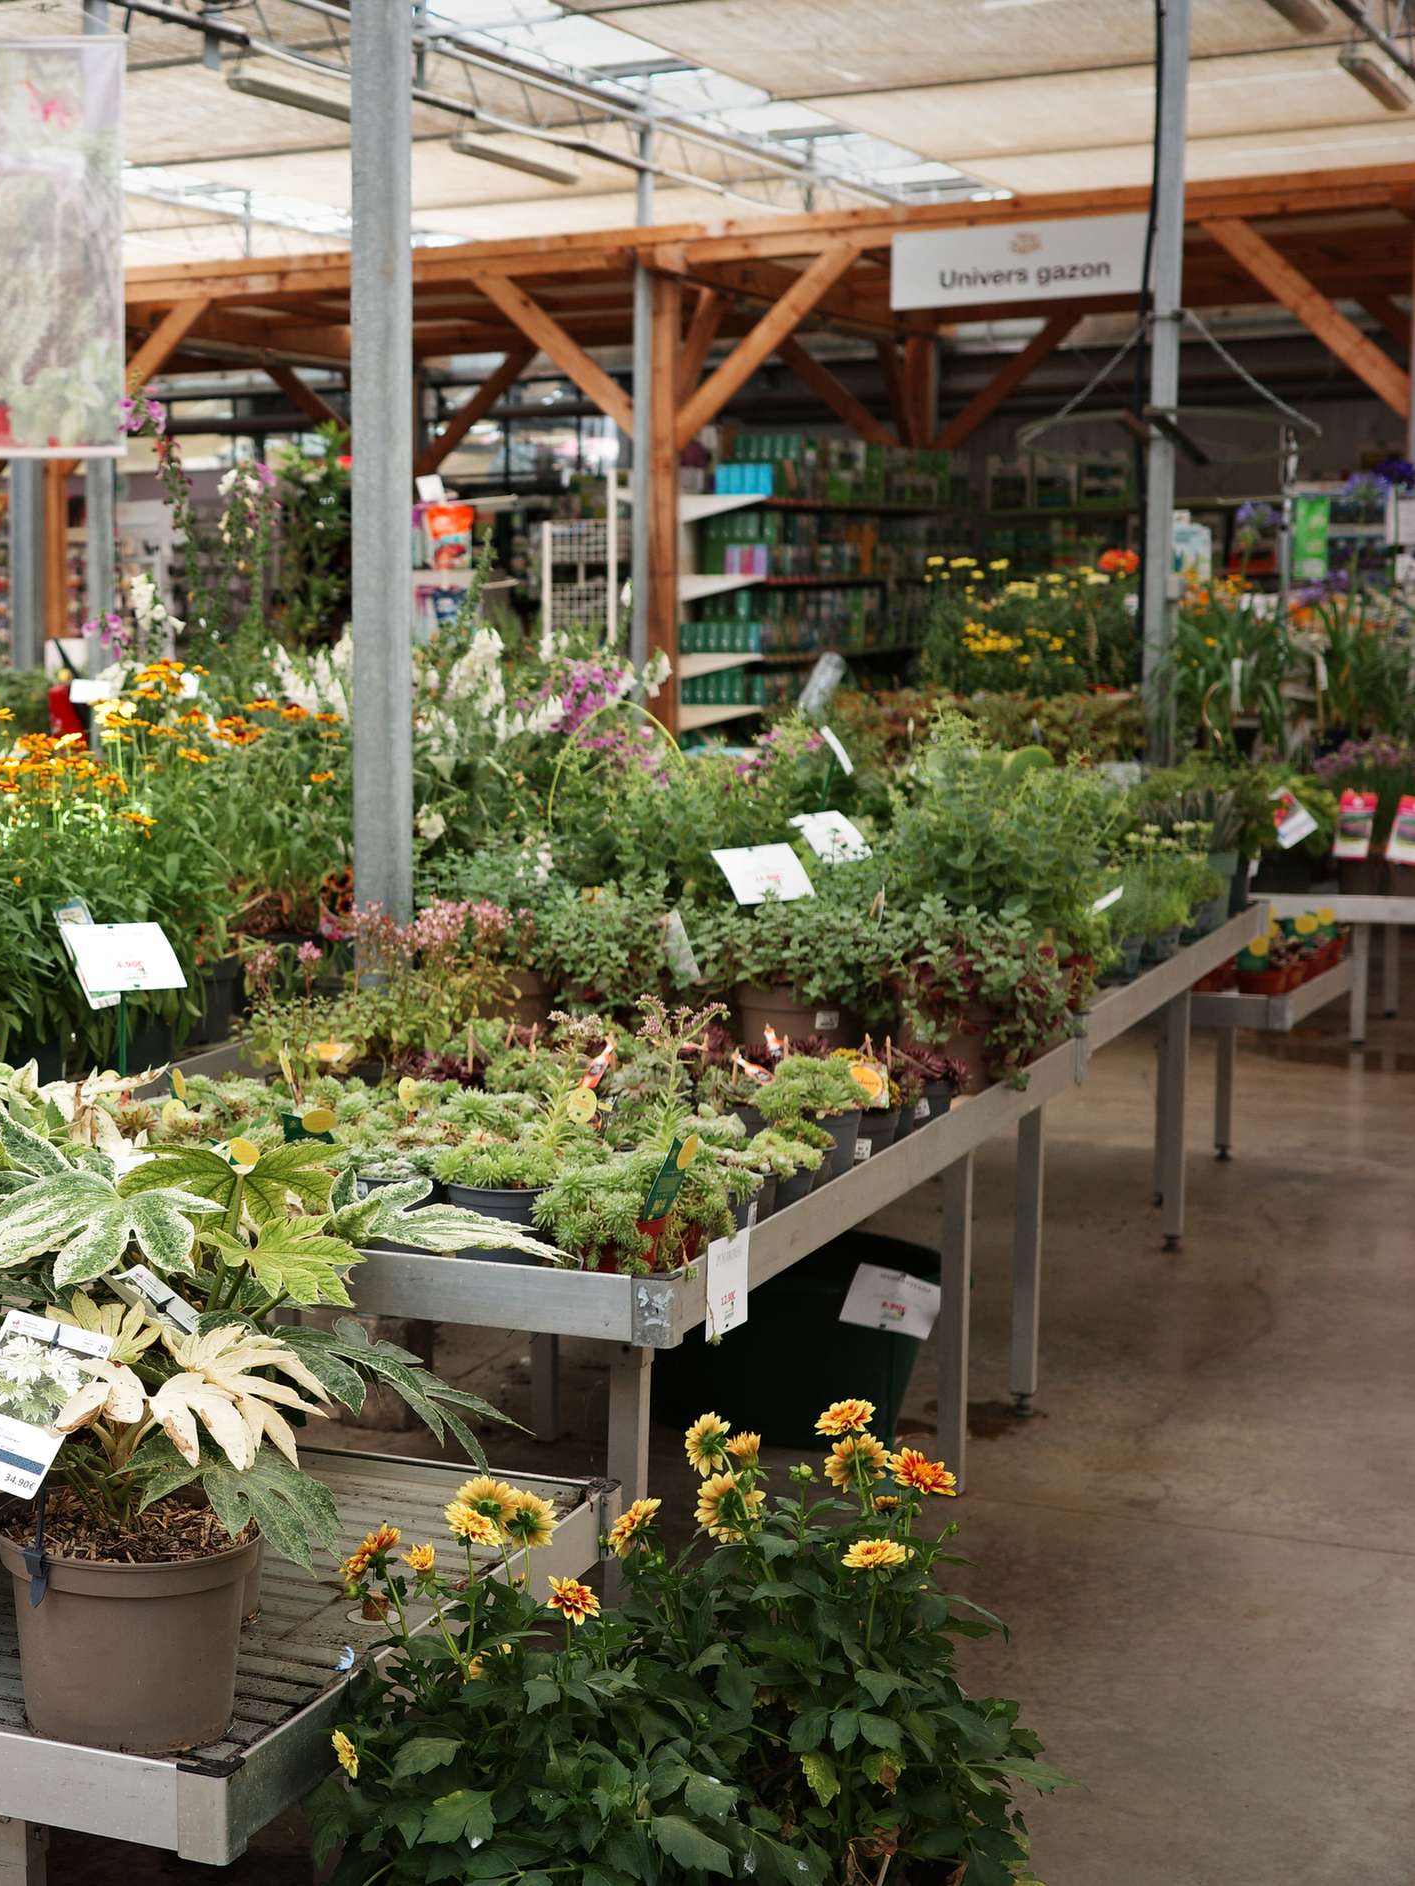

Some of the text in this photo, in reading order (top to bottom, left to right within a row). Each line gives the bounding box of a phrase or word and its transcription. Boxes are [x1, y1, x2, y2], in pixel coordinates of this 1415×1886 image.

[939, 260, 1112, 290] Univers gazon
[3, 1473, 37, 1491] 34.90€
